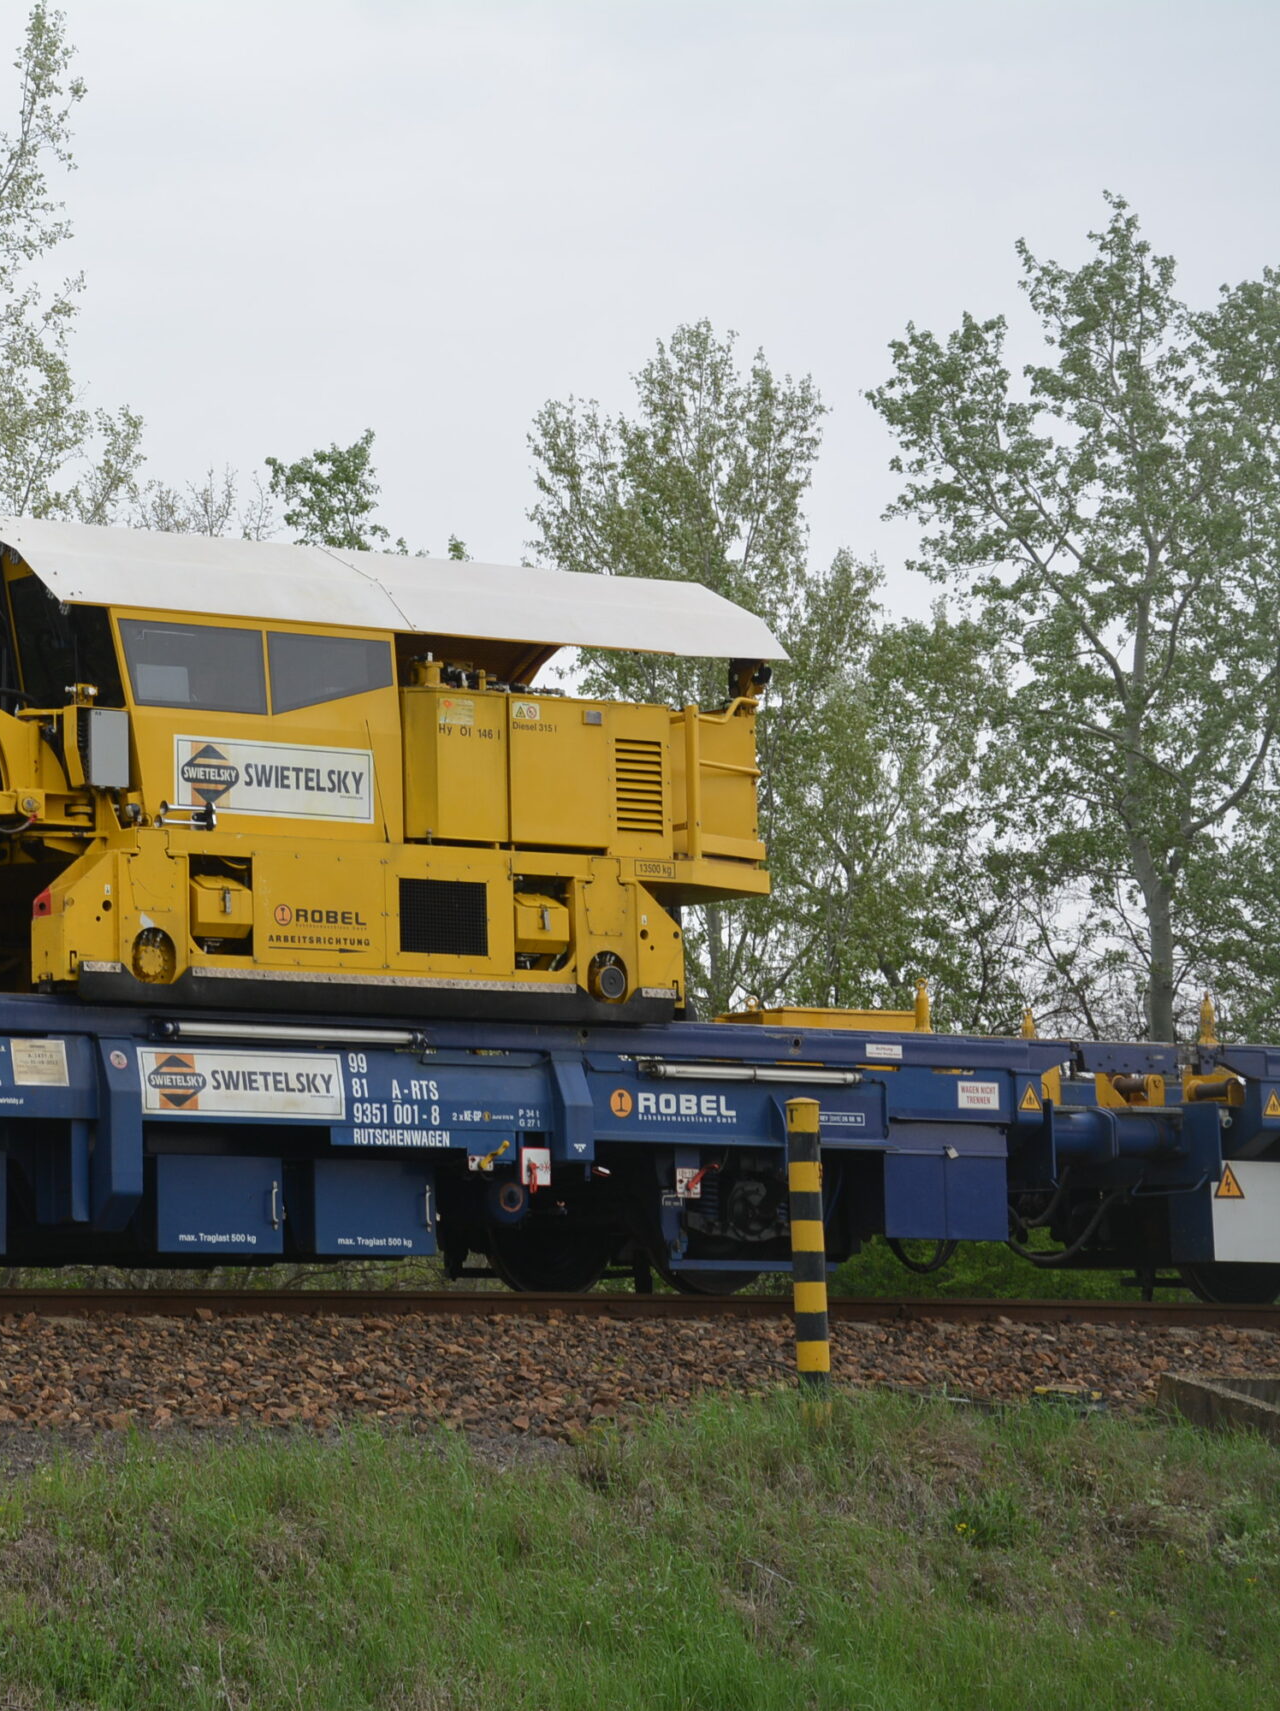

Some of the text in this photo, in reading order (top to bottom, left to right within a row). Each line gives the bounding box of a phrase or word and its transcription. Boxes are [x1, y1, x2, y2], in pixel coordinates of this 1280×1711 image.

[438, 724, 452, 736] Hy
[478, 729, 493, 740] 146
[513, 722, 536, 730] Diesel
[538, 724, 552, 732] 315
[184, 766, 236, 782] SWIETELSKY
[244, 763, 364, 794] SWIETELSKY
[640, 864, 672, 876] 13500 kg
[296, 909, 366, 926] ROBEL
[268, 934, 370, 946] ARBEITSRICHTUNG
[348, 1053, 368, 1074] 99
[150, 1074, 204, 1088] SWIETELSKY
[211, 1069, 332, 1094] SWIETELSKY
[352, 1078, 368, 1098] 81
[960, 1086, 996, 1096] WAGEN NICHT
[638, 1092, 736, 1116] ROBEL
[966, 1096, 991, 1104] TRENNEN
[354, 1102, 388, 1124] 9351
[394, 1104, 418, 1125] 001
[518, 1108, 524, 1118] P
[526, 1110, 535, 1118] 34
[638, 1114, 712, 1123] Bahnbaumaschinen
[519, 1118, 526, 1127] G
[527, 1119, 535, 1128] 27
[354, 1128, 450, 1148] RUTSCHENWAGEN
[179, 1233, 256, 1244] max. Traglast 500 kg
[338, 1236, 412, 1248] max. Traglast 500 kg
